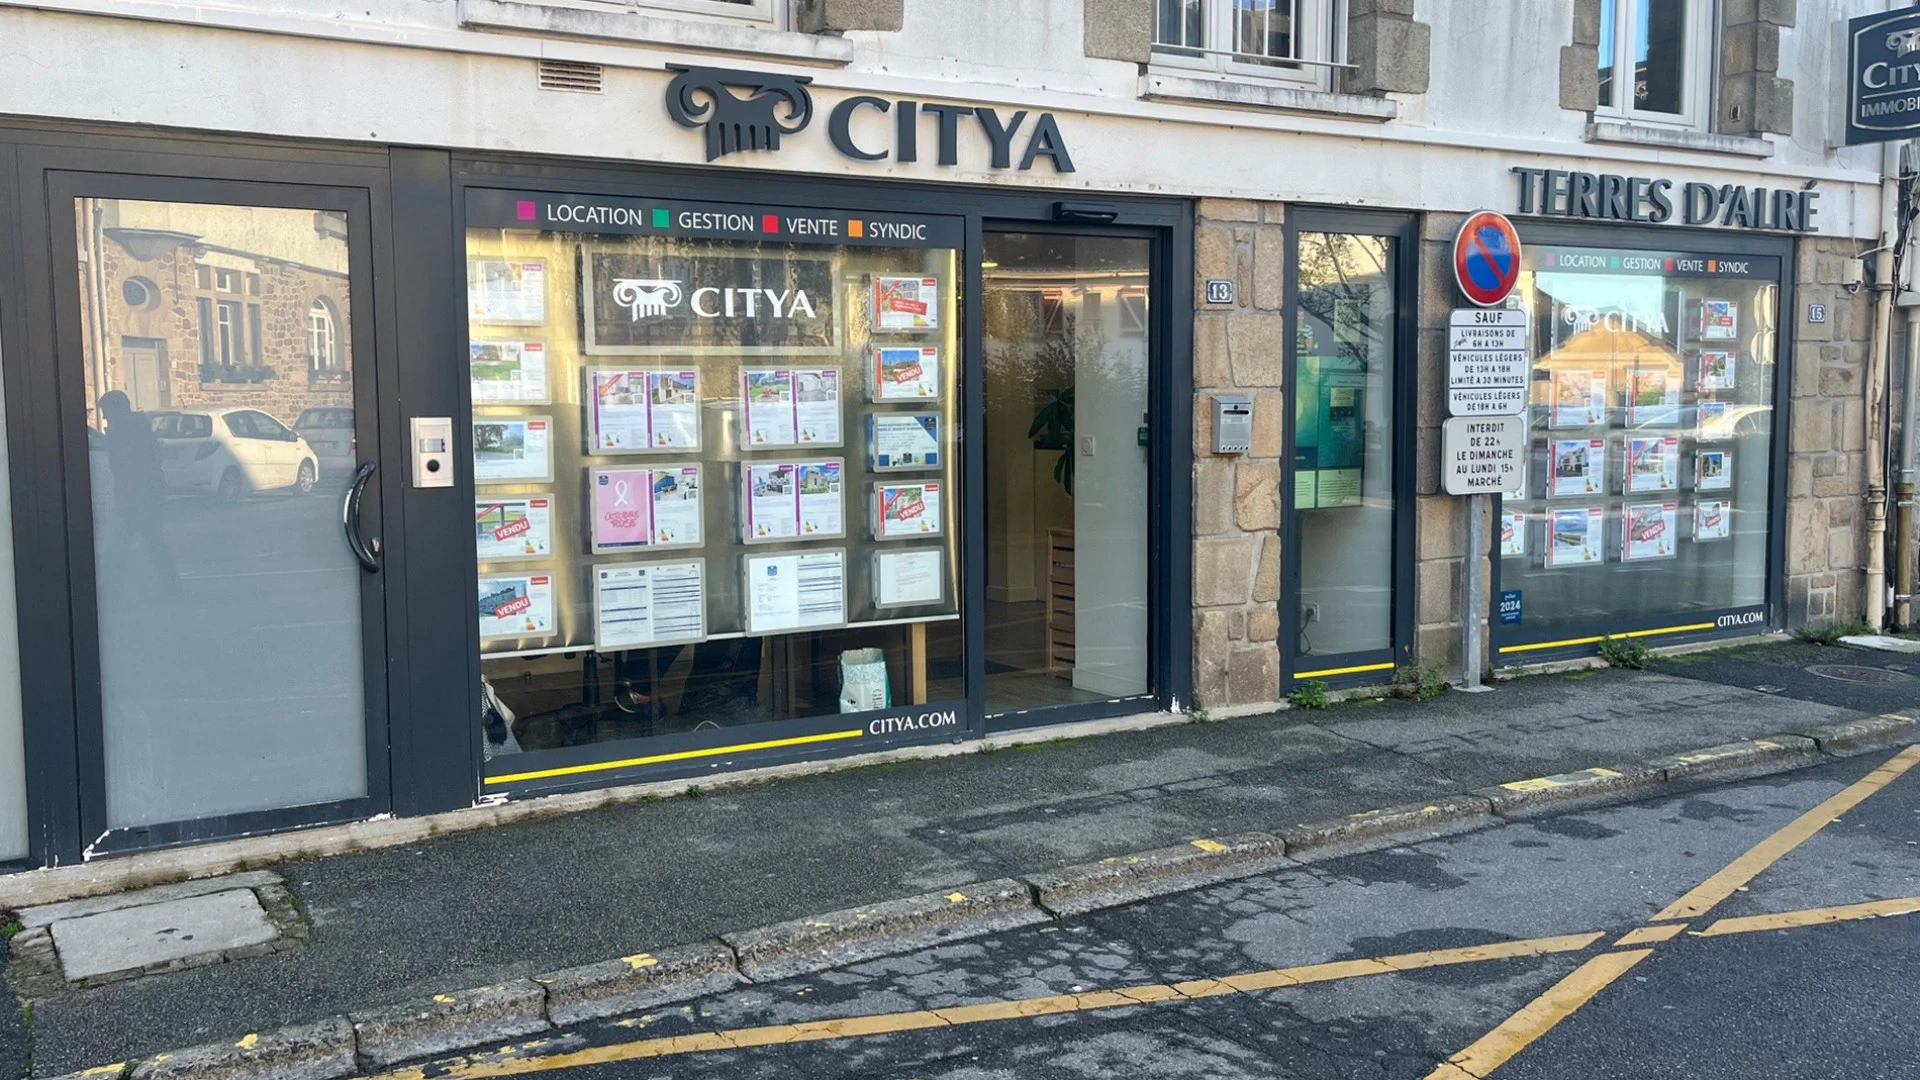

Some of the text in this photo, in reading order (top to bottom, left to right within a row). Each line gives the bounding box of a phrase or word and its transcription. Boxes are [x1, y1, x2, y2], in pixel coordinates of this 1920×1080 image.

[828, 95, 1076, 173] CITYA
[1510, 166, 1820, 232] TERRES D'ALRÉ
[547, 203, 927, 241] LOCATION GESTION VENTE SYNDIC
[1559, 254, 1749, 274] LOCATION GESTION VENTE SYNDIC
[1211, 284, 1228, 300] 13
[690, 287, 817, 319] CITYA
[1475, 312, 1503, 323] SAUF
[1811, 306, 1823, 320] 15
[1603, 310, 1670, 333] CITYA
[1461, 329, 1516, 338] LIVRAISONS DE
[1453, 351, 1522, 362] VÉHICULES LÉGERS
[1465, 365, 1474, 373] DE
[1477, 365, 1489, 373] 13H
[1451, 375, 1474, 385] LIMITÉ
[1494, 375, 1523, 384] MINUTES
[1453, 390, 1521, 400] VÉHICULES LÉGERS
[1467, 403, 1476, 411] DE
[1498, 402, 1508, 410] 6H
[1466, 423, 1505, 433] INTERDIT
[1470, 436, 1501, 446] DE 22h
[1456, 449, 1513, 461] LE DIMANCHE
[1456, 465, 1468, 474] AU
[1471, 463, 1496, 474] LUNDI
[1467, 476, 1503, 487] MARCHÉ
[899, 503, 923, 519] VENDU
[496, 520, 528, 538] VENDU
[1641, 521, 1665, 540] VENDU
[497, 597, 529, 616] VENDU
[1499, 600, 1521, 612] 2024
[1717, 611, 1764, 627] CITYA.COM
[869, 710, 957, 735] CITYA.COM
